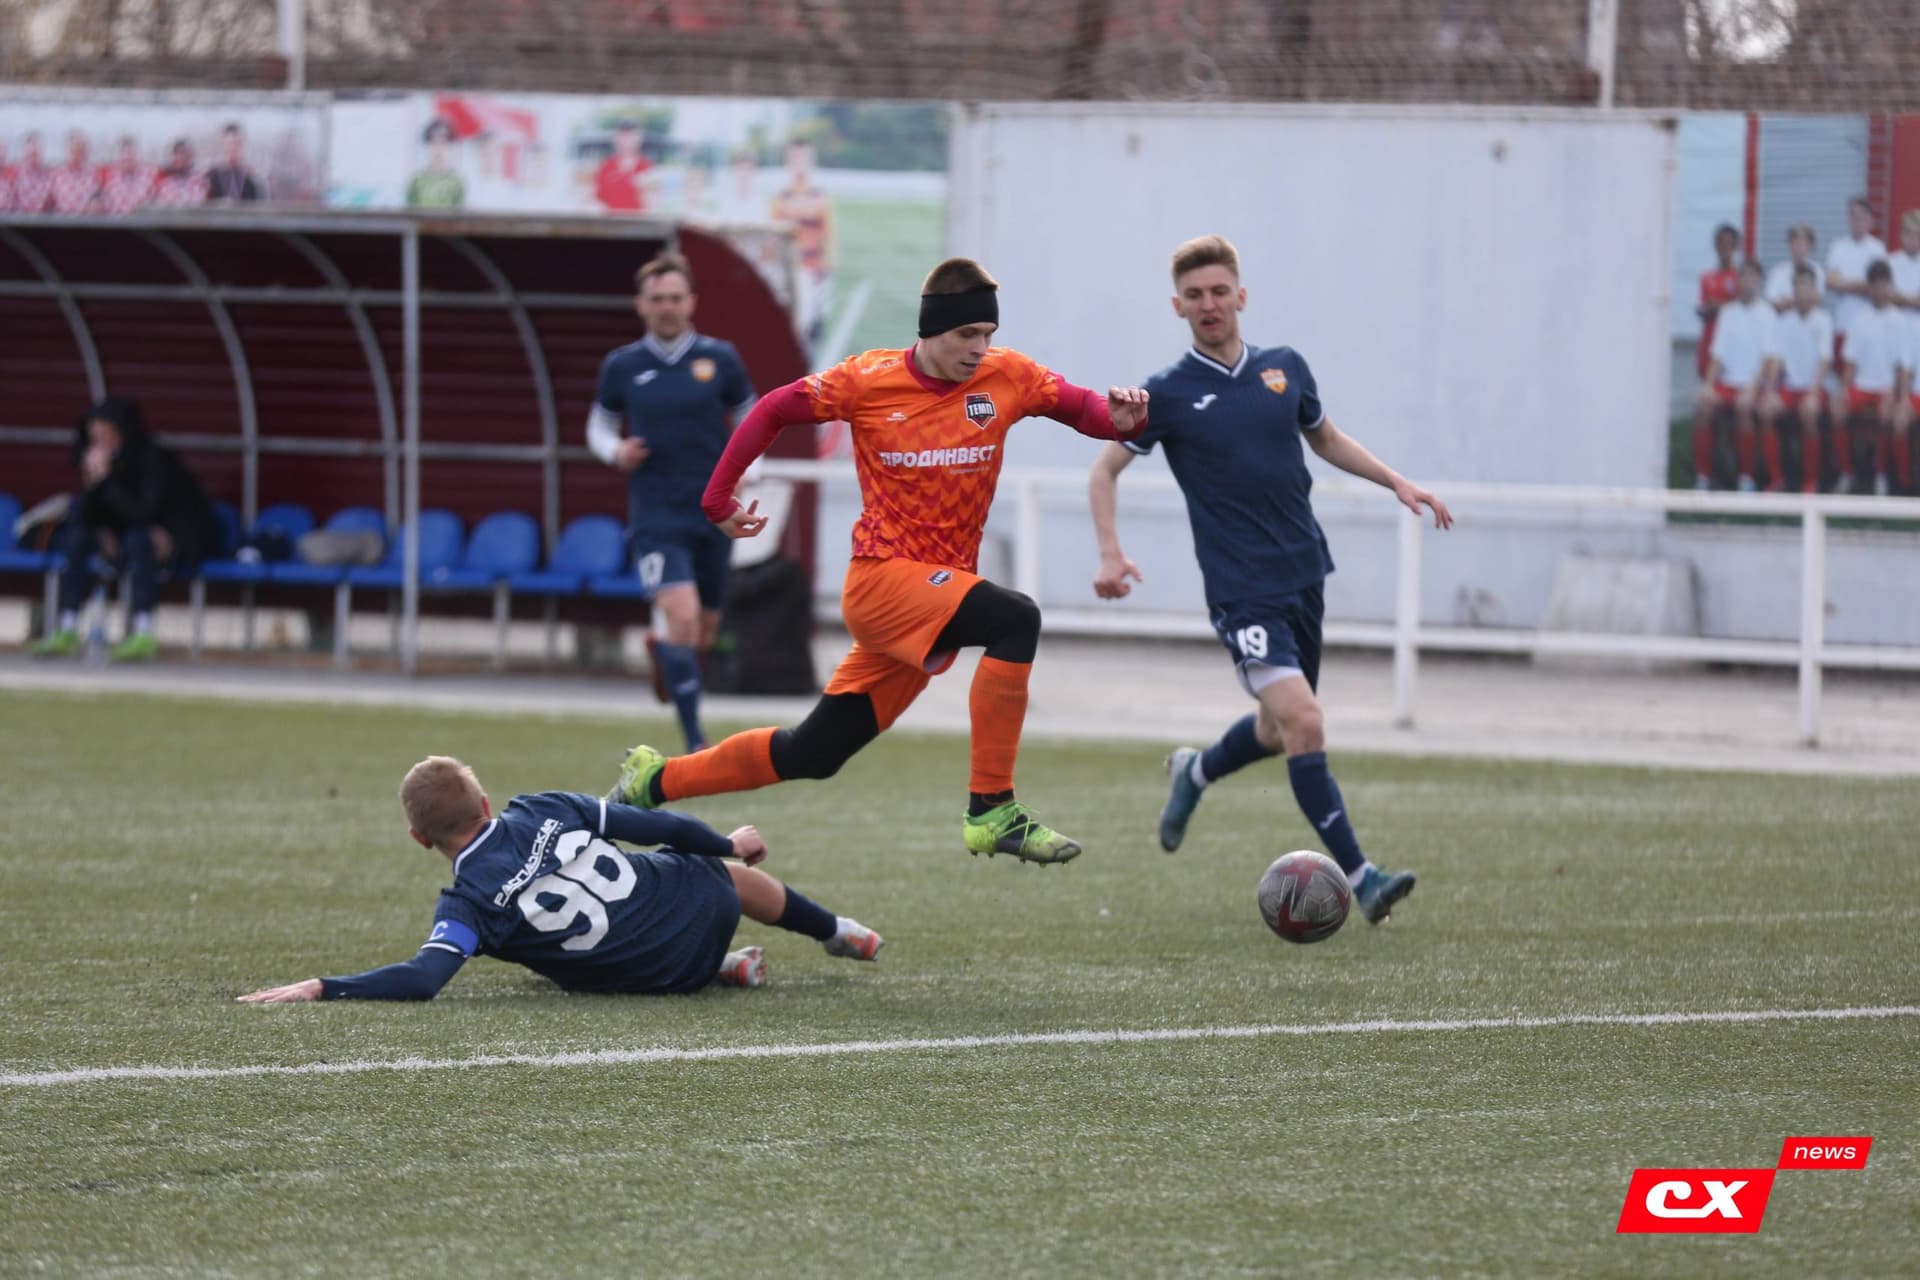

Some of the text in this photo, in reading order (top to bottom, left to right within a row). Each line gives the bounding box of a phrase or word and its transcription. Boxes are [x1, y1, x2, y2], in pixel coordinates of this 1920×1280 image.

[967, 403, 994, 416] ТЕМП
[879, 445, 996, 468] ПРОДИНВЕСТ
[1237, 625, 1268, 658] 19
[517, 830, 638, 951] 96
